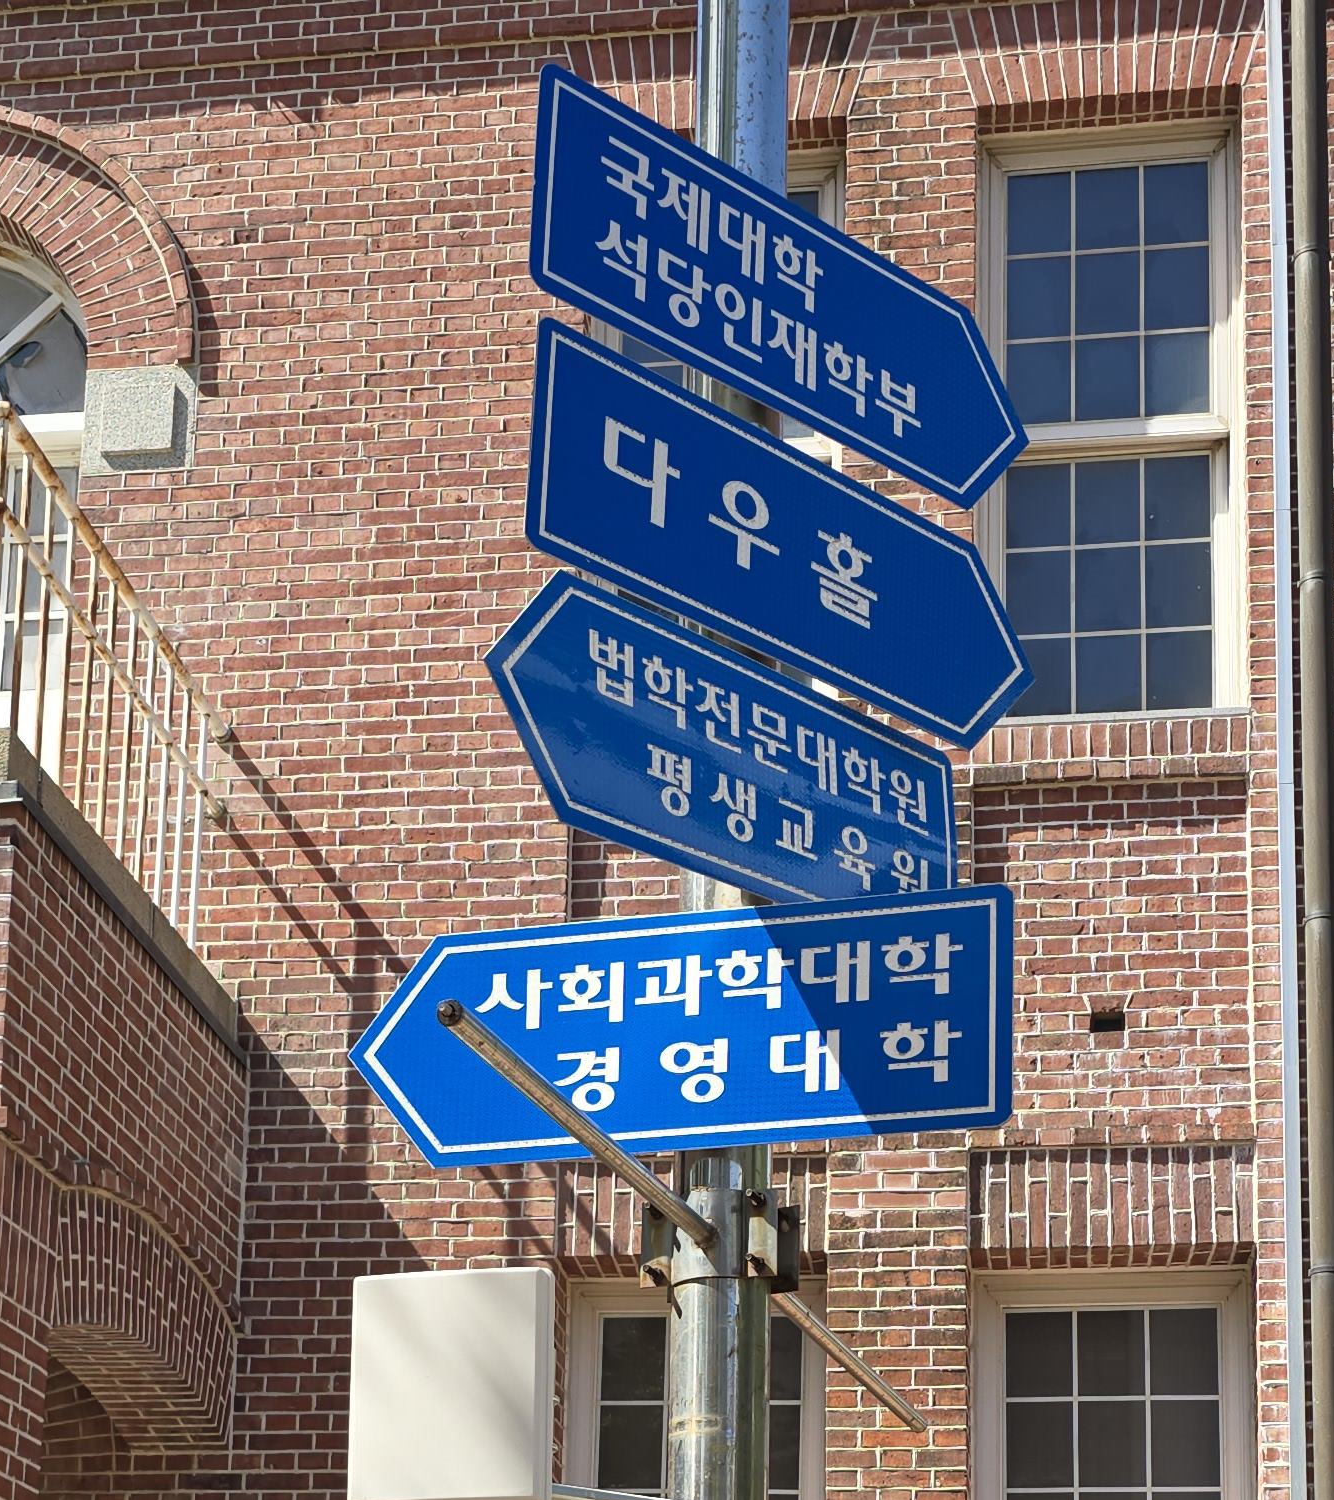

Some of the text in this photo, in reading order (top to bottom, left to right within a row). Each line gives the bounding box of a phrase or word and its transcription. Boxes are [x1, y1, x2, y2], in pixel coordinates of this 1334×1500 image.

[600, 134, 825, 313] 국제대학
[595, 219, 922, 439] 석당인재학부
[588, 628, 930, 837] 법학전문대학원
[474, 932, 964, 1030] 사회과학대학
